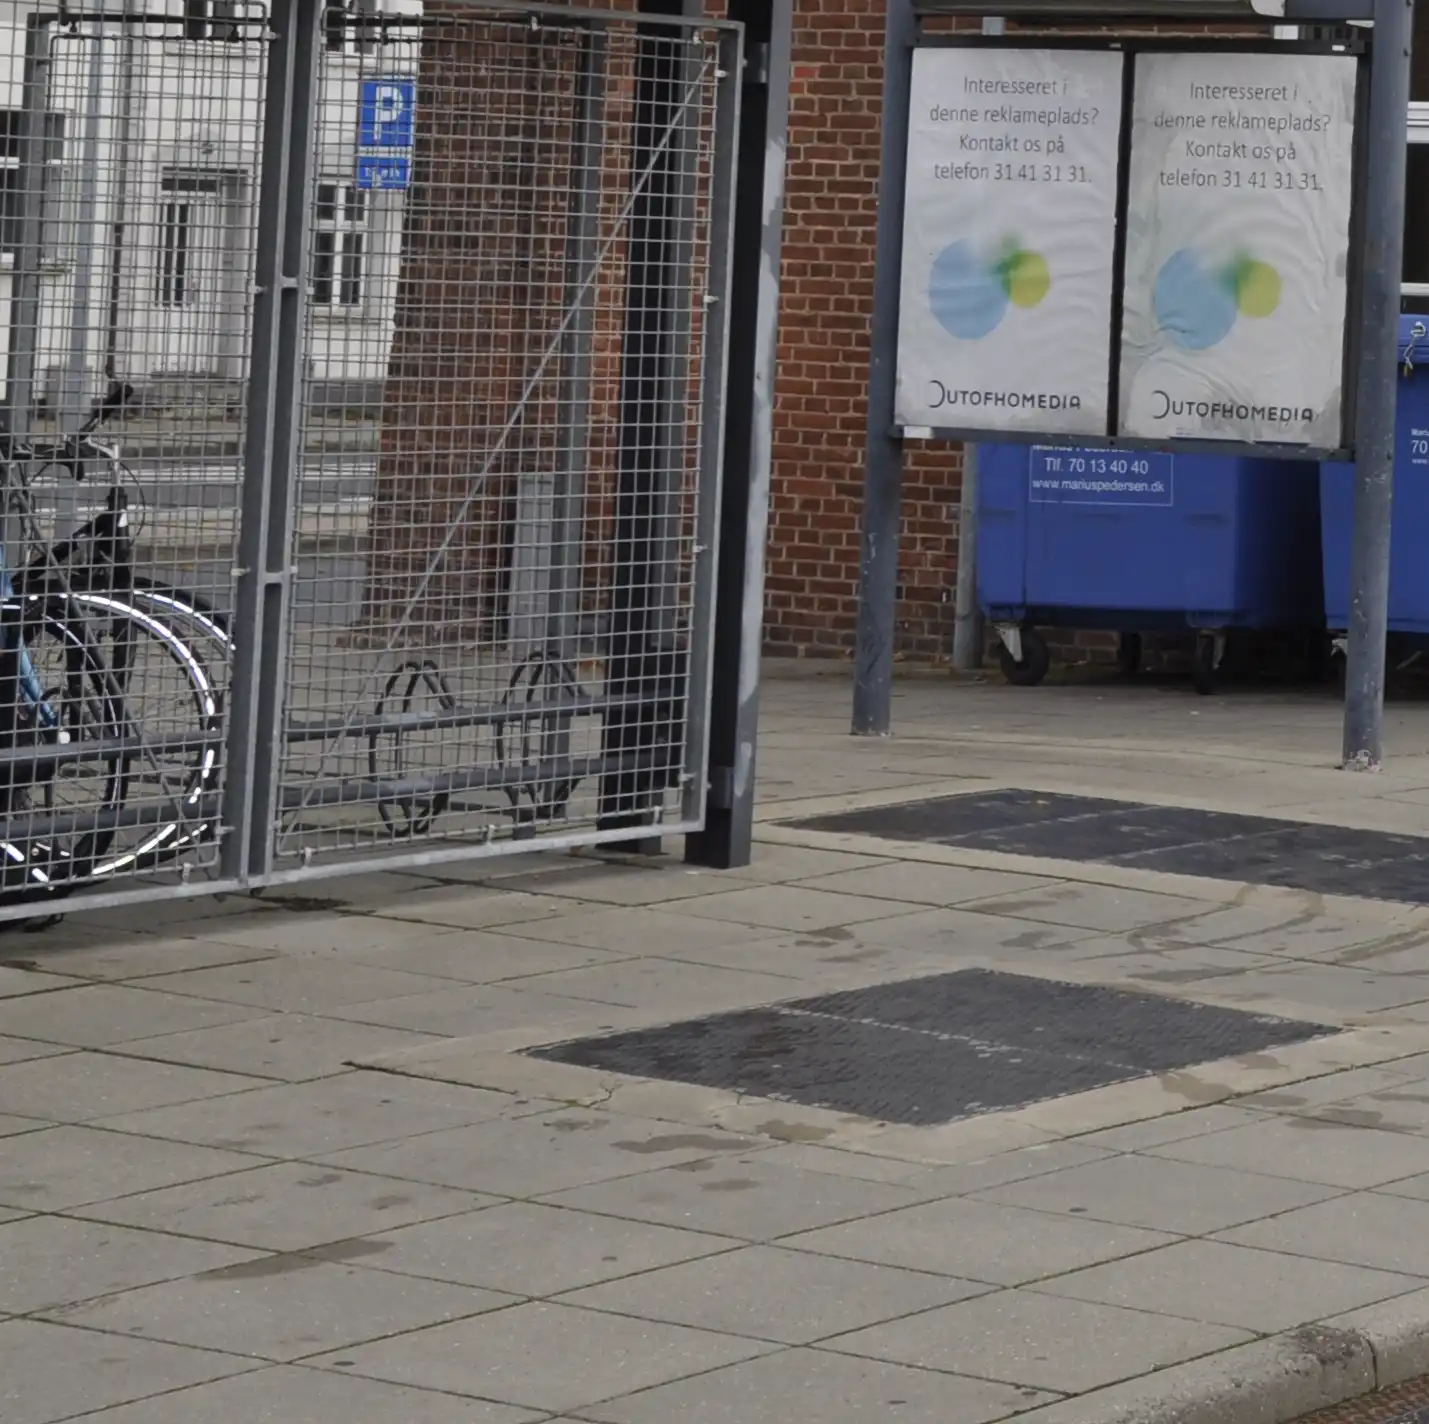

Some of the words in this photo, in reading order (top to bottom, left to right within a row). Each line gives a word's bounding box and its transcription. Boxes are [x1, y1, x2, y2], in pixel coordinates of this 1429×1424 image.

[963, 76, 1058, 95] Interesseret
[1062, 78, 1068, 95] i
[1189, 82, 1288, 101] Interesseret
[1292, 83, 1298, 101] i
[373, 86, 404, 141] P
[929, 104, 979, 123] denne
[984, 106, 1099, 127] reklameplads?
[1153, 111, 1205, 128] denne
[1211, 112, 1331, 134] reklameplads?
[959, 134, 1018, 152] Kontakt
[1023, 138, 1041, 153] os
[1046, 134, 1064, 156] på
[1186, 140, 1247, 158] Kontakt
[1252, 145, 1271, 159] os
[1276, 142, 1296, 163] på
[934, 162, 989, 180] telefon
[993, 164, 1012, 181] 31
[1018, 164, 1036, 181] 41
[1042, 165, 1061, 182] 31
[1067, 165, 1092, 183] 31.
[1160, 168, 1217, 187] telefon
[1221, 170, 1241, 188] 31
[1247, 171, 1267, 189] 41
[1273, 172, 1292, 189] 31
[1411, 440, 1428, 454] 70
[1044, 457, 1064, 472] Tlf.
[1068, 458, 1085, 473] 70
[1090, 459, 1106, 474] 13
[1110, 460, 1128, 474] 40
[1130, 460, 1149, 475] 40
[1032, 479, 1165, 493] www.mariuspedersen.dk
